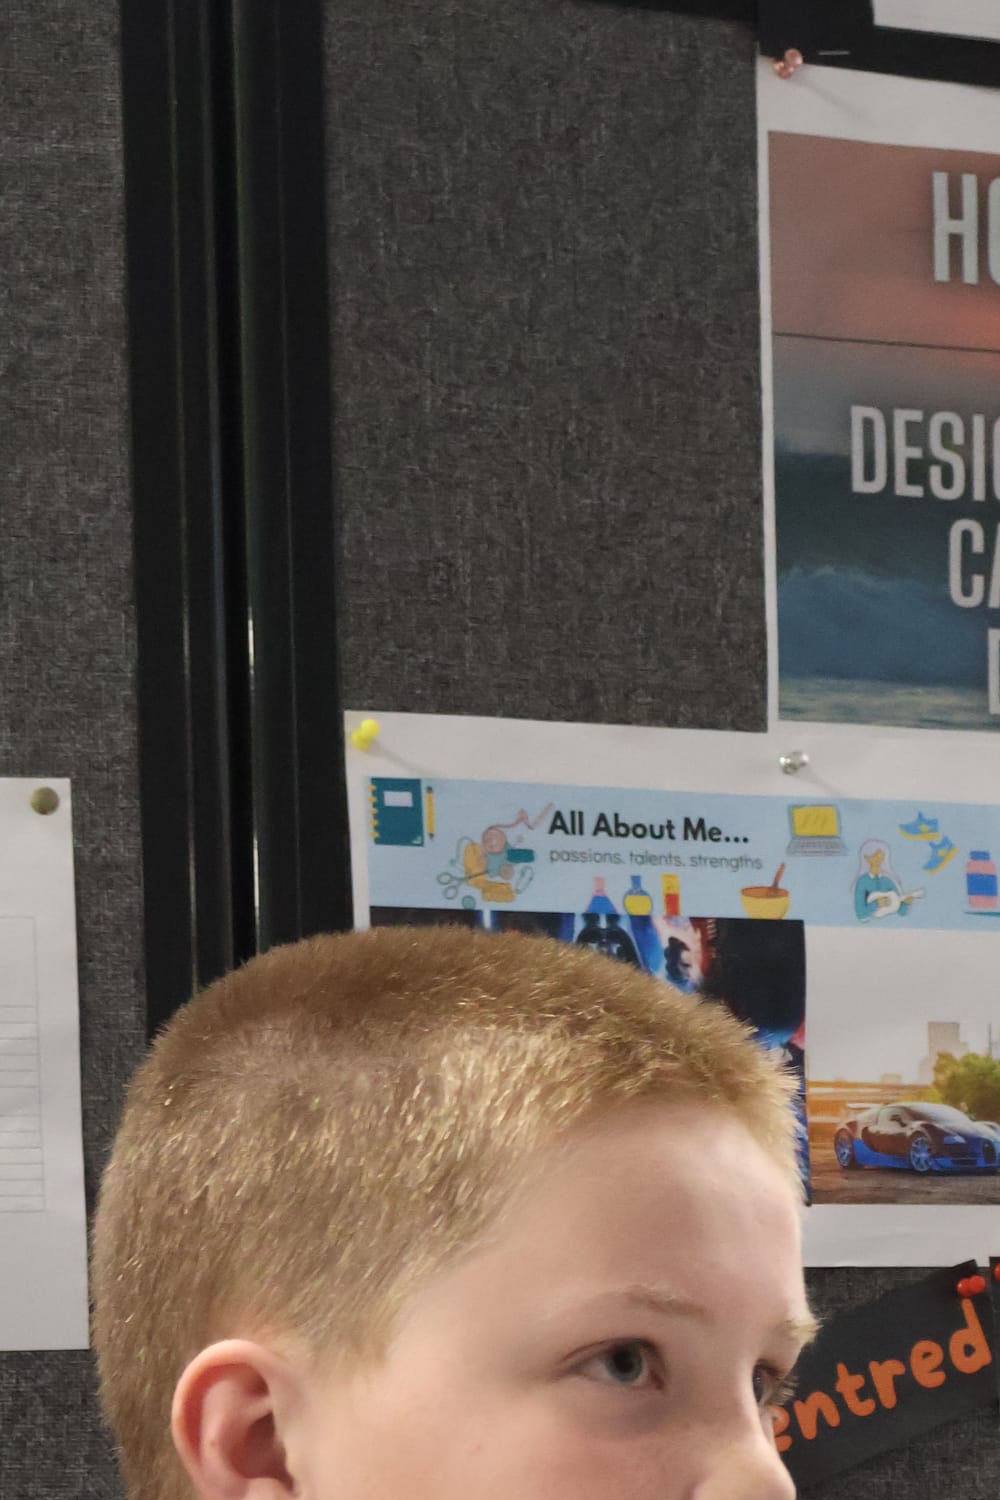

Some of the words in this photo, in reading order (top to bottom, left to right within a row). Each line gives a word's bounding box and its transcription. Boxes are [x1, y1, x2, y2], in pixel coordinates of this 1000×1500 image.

[548, 809, 584, 836] All
[592, 812, 676, 840] About
[683, 816, 749, 843] Me...
[689, 854, 764, 873] strengths
[770, 1298, 992, 1452] entred
